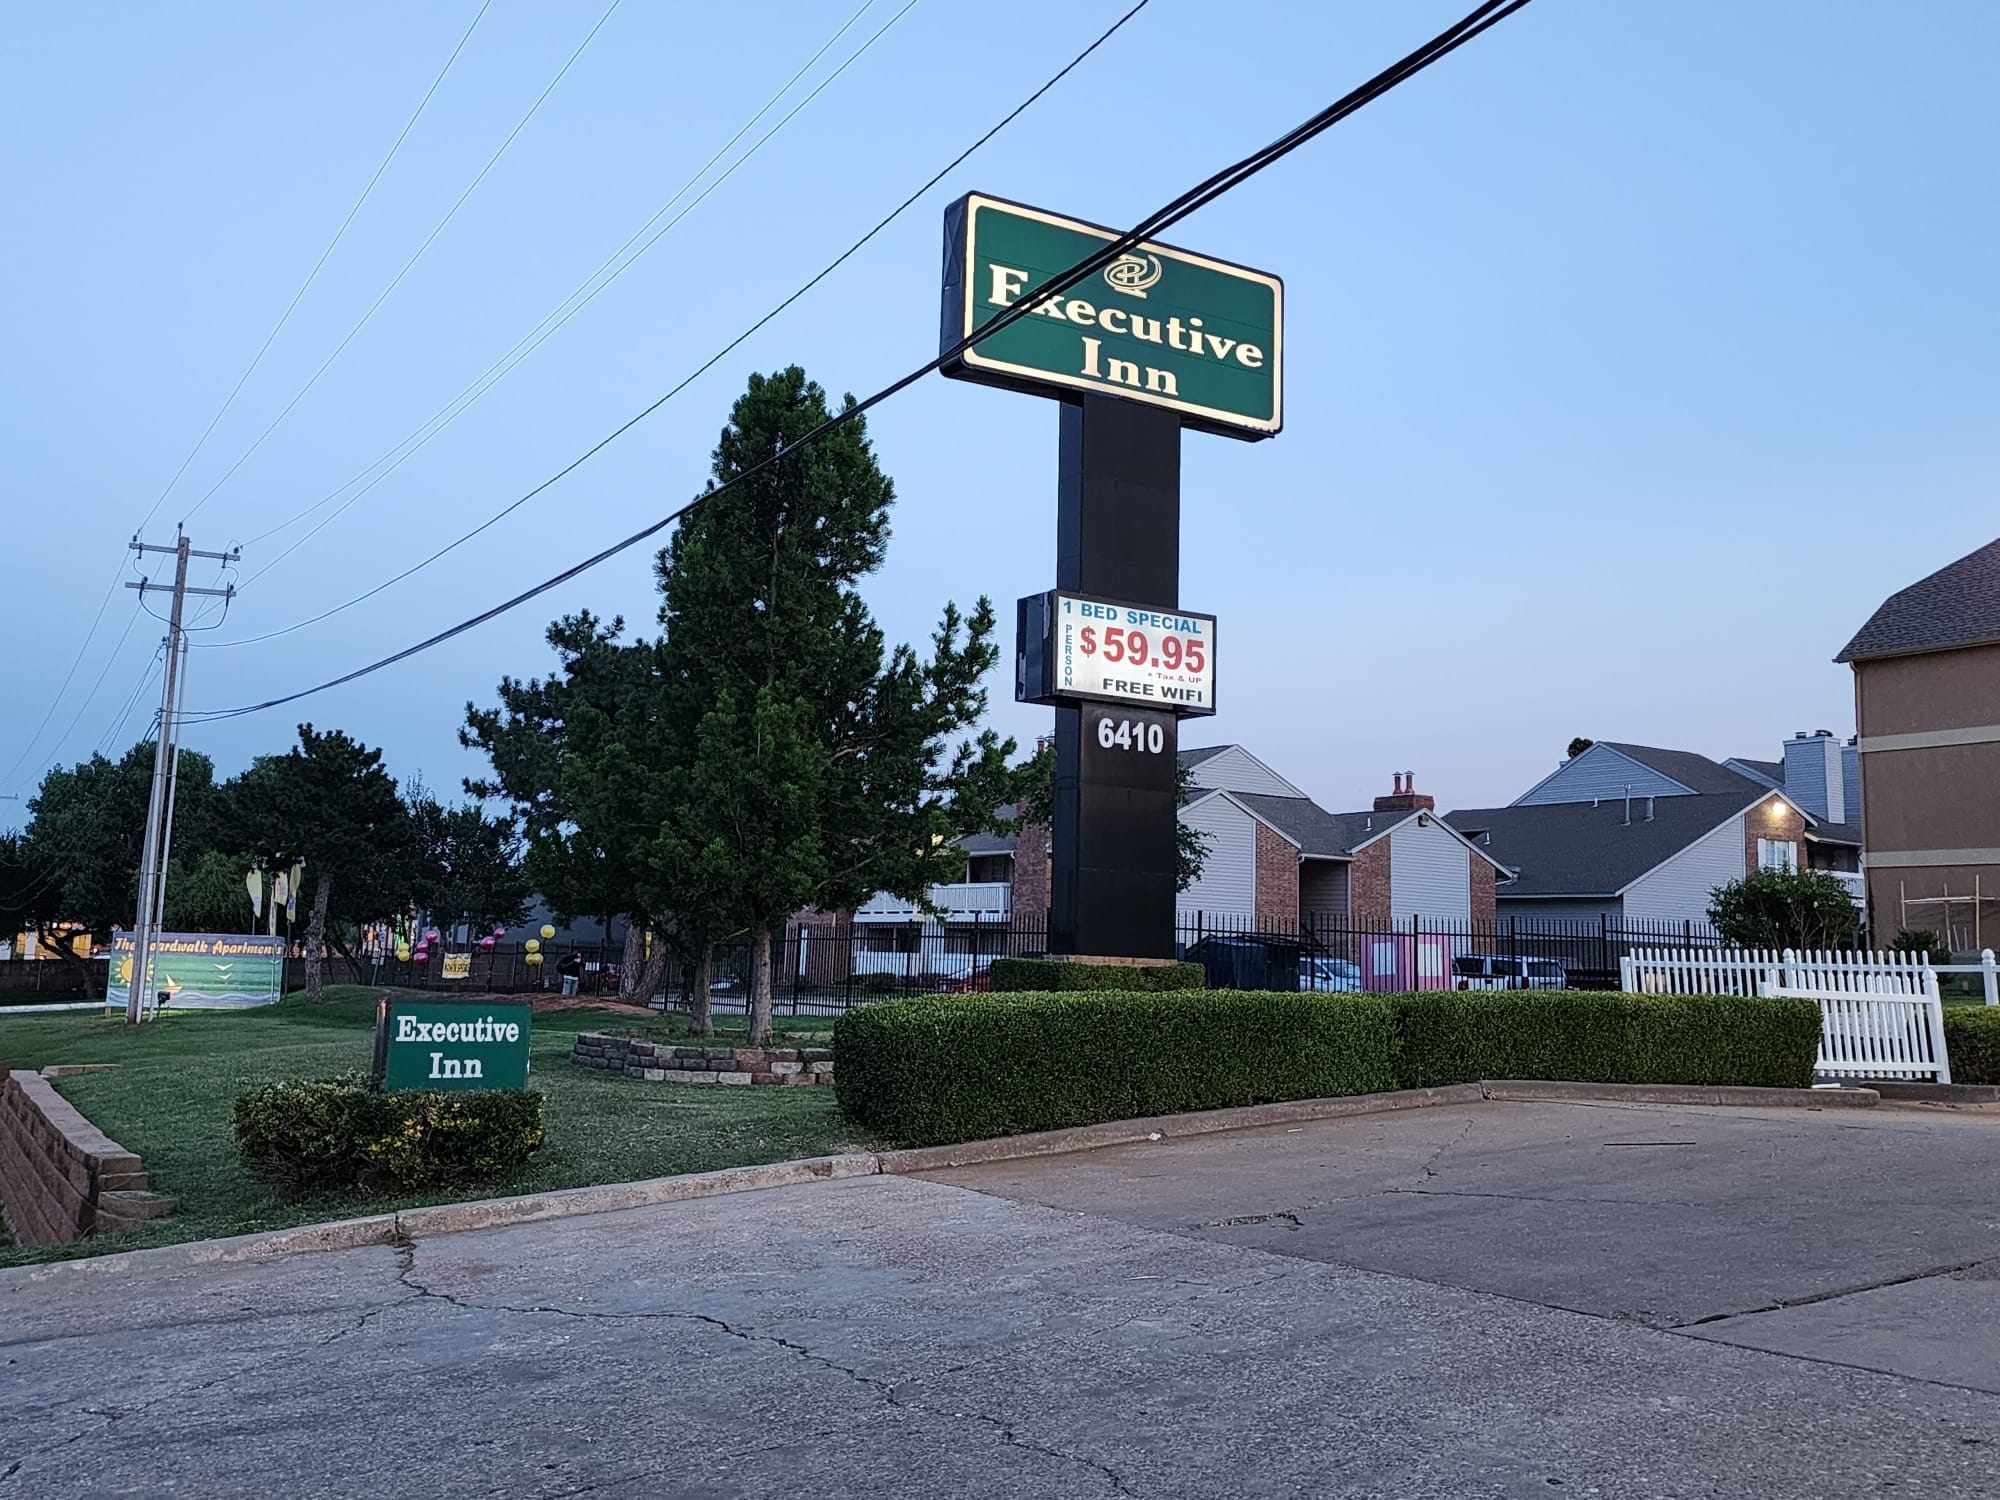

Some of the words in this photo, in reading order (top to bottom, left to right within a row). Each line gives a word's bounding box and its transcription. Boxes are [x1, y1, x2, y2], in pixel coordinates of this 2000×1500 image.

[988, 263, 1264, 368] Executive
[1080, 336, 1179, 396] Inn
[1063, 600, 1072, 614] 1
[1081, 603, 1118, 621] BED
[1127, 611, 1202, 634] SPECIAL
[1065, 624, 1073, 687] PERSON
[1080, 625, 1205, 674] $59.95
[1103, 678, 1154, 697] FREE
[1161, 686, 1202, 702] WIFI
[1156, 672, 1174, 681] Tax
[1188, 676, 1202, 684] UP
[1098, 717, 1164, 754] 6410
[114, 937, 136, 951] The
[149, 939, 208, 953] oardwalk
[395, 1015, 520, 1043] Executive
[428, 1052, 484, 1079] Inn
